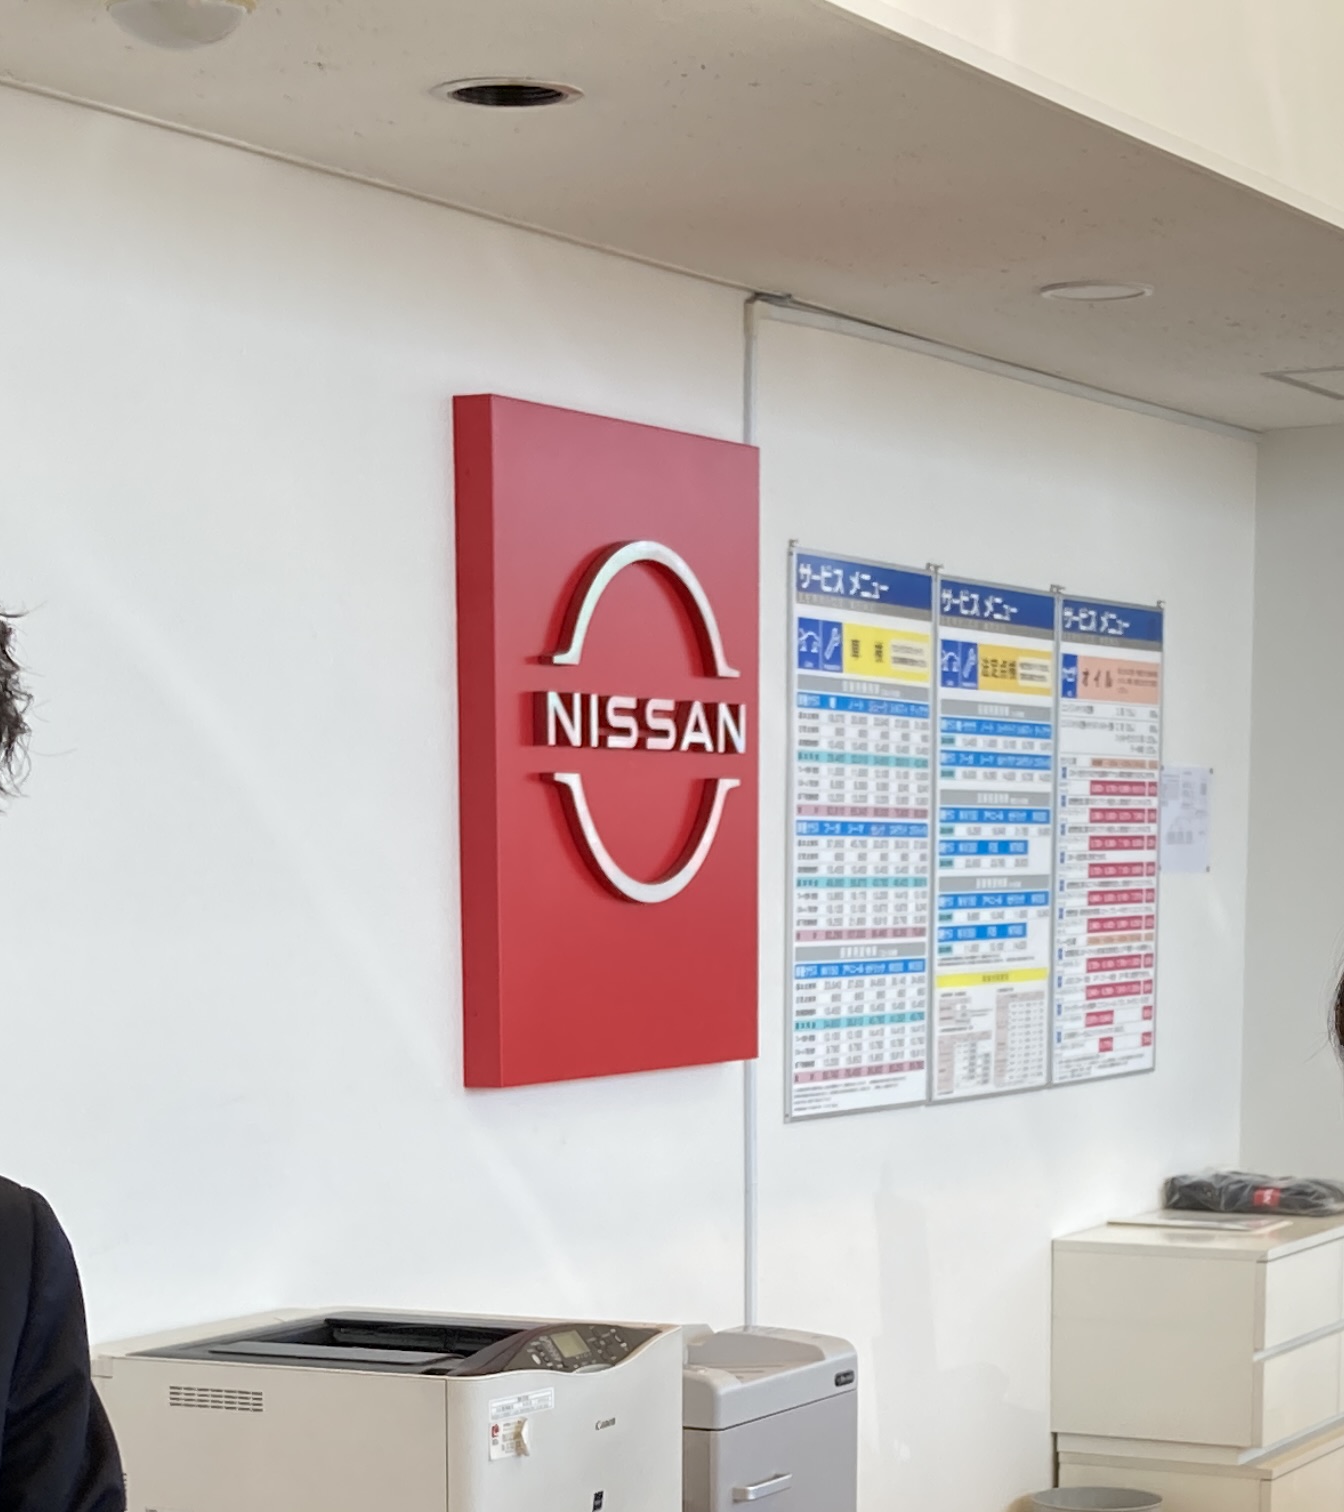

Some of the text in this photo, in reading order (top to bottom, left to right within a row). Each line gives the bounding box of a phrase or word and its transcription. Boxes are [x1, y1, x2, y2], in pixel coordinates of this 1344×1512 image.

[798, 562, 890, 599] サービス メニュー
[941, 588, 1018, 621] サービス メニュー
[1063, 606, 1130, 636] サービス メニュー
[545, 690, 747, 755] NISSAN
[595, 1417, 616, 1431] Canon
